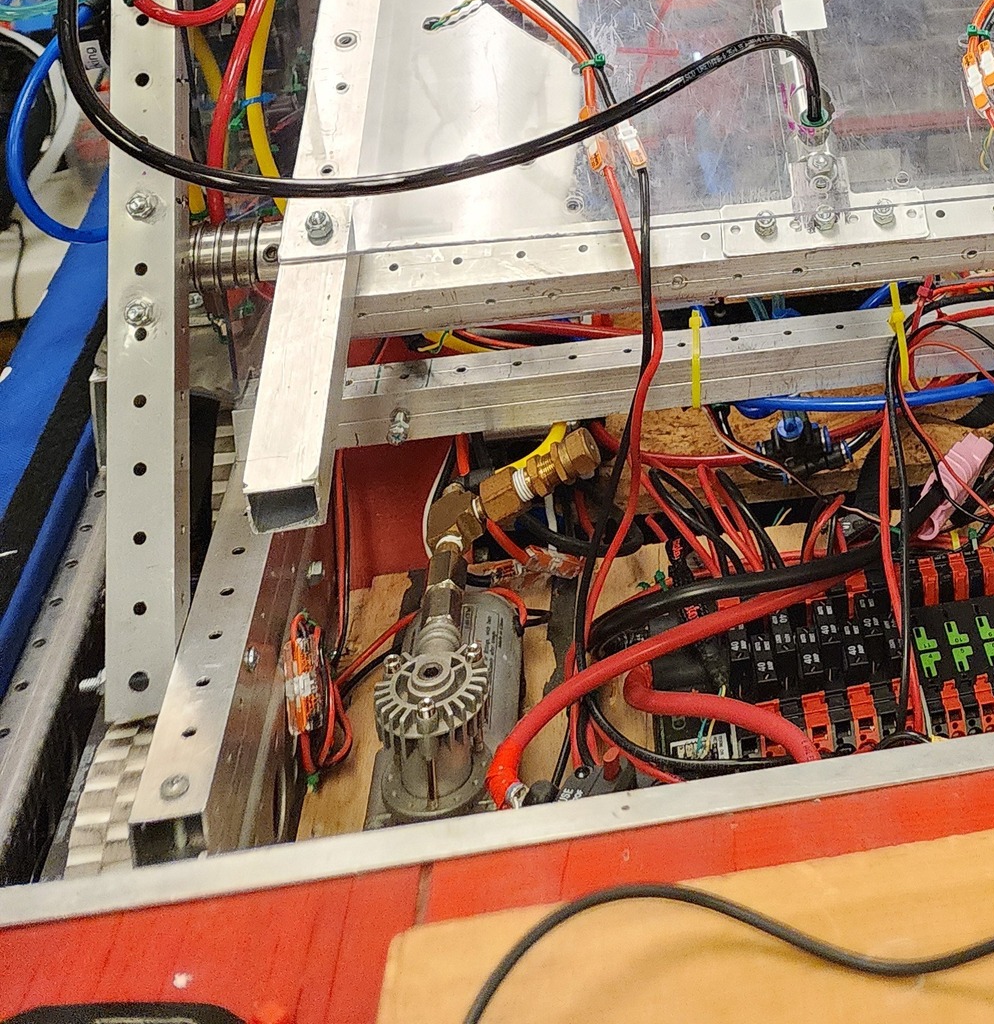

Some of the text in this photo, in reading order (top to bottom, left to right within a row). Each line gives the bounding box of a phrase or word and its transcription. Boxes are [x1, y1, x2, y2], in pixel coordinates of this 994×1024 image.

[864, 618, 872, 627] 40
[821, 625, 830, 635] 40
[730, 641, 739, 651] 40
[848, 645, 857, 656] 40
[803, 653, 812, 664] 40
[757, 661, 766, 672] 40
